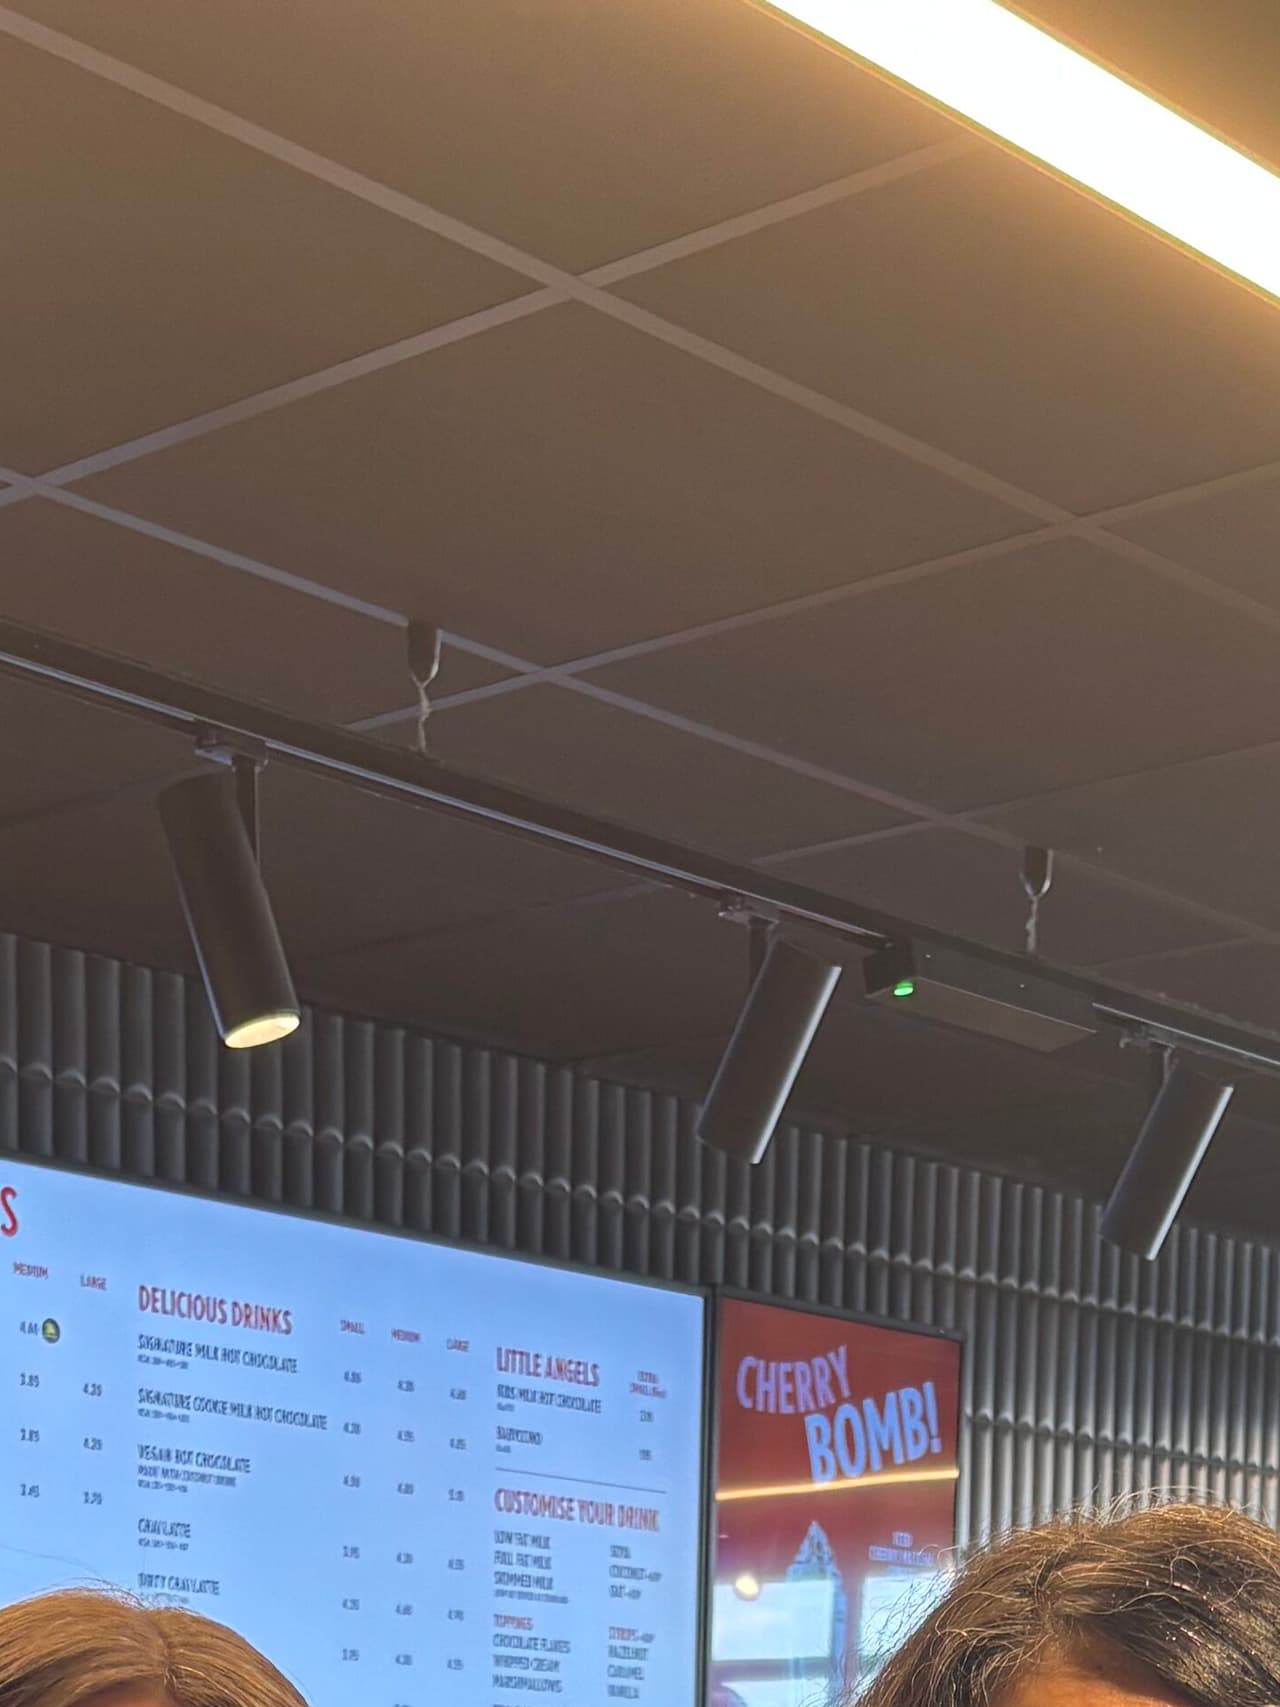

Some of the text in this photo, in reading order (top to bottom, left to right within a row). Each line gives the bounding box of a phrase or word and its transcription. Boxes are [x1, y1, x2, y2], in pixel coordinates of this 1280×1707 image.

[13, 1261, 48, 1279] MEDIUM
[80, 1273, 107, 1291] LARGE
[138, 1284, 293, 1336] DELICIOUS DRINKS
[138, 1334, 192, 1357] SIGNATURE
[242, 1351, 297, 1374] CHOCOLATE
[496, 1347, 600, 1387] LITTLE ANGELS
[736, 1345, 852, 1415] CHERRY
[804, 1381, 943, 1486] BOMB!
[195, 1452, 251, 1473] CHOCOLATE
[494, 1488, 574, 1521] CUSTOMISE
[577, 1498, 615, 1526] YOUR
[618, 1505, 659, 1532] DRINK
